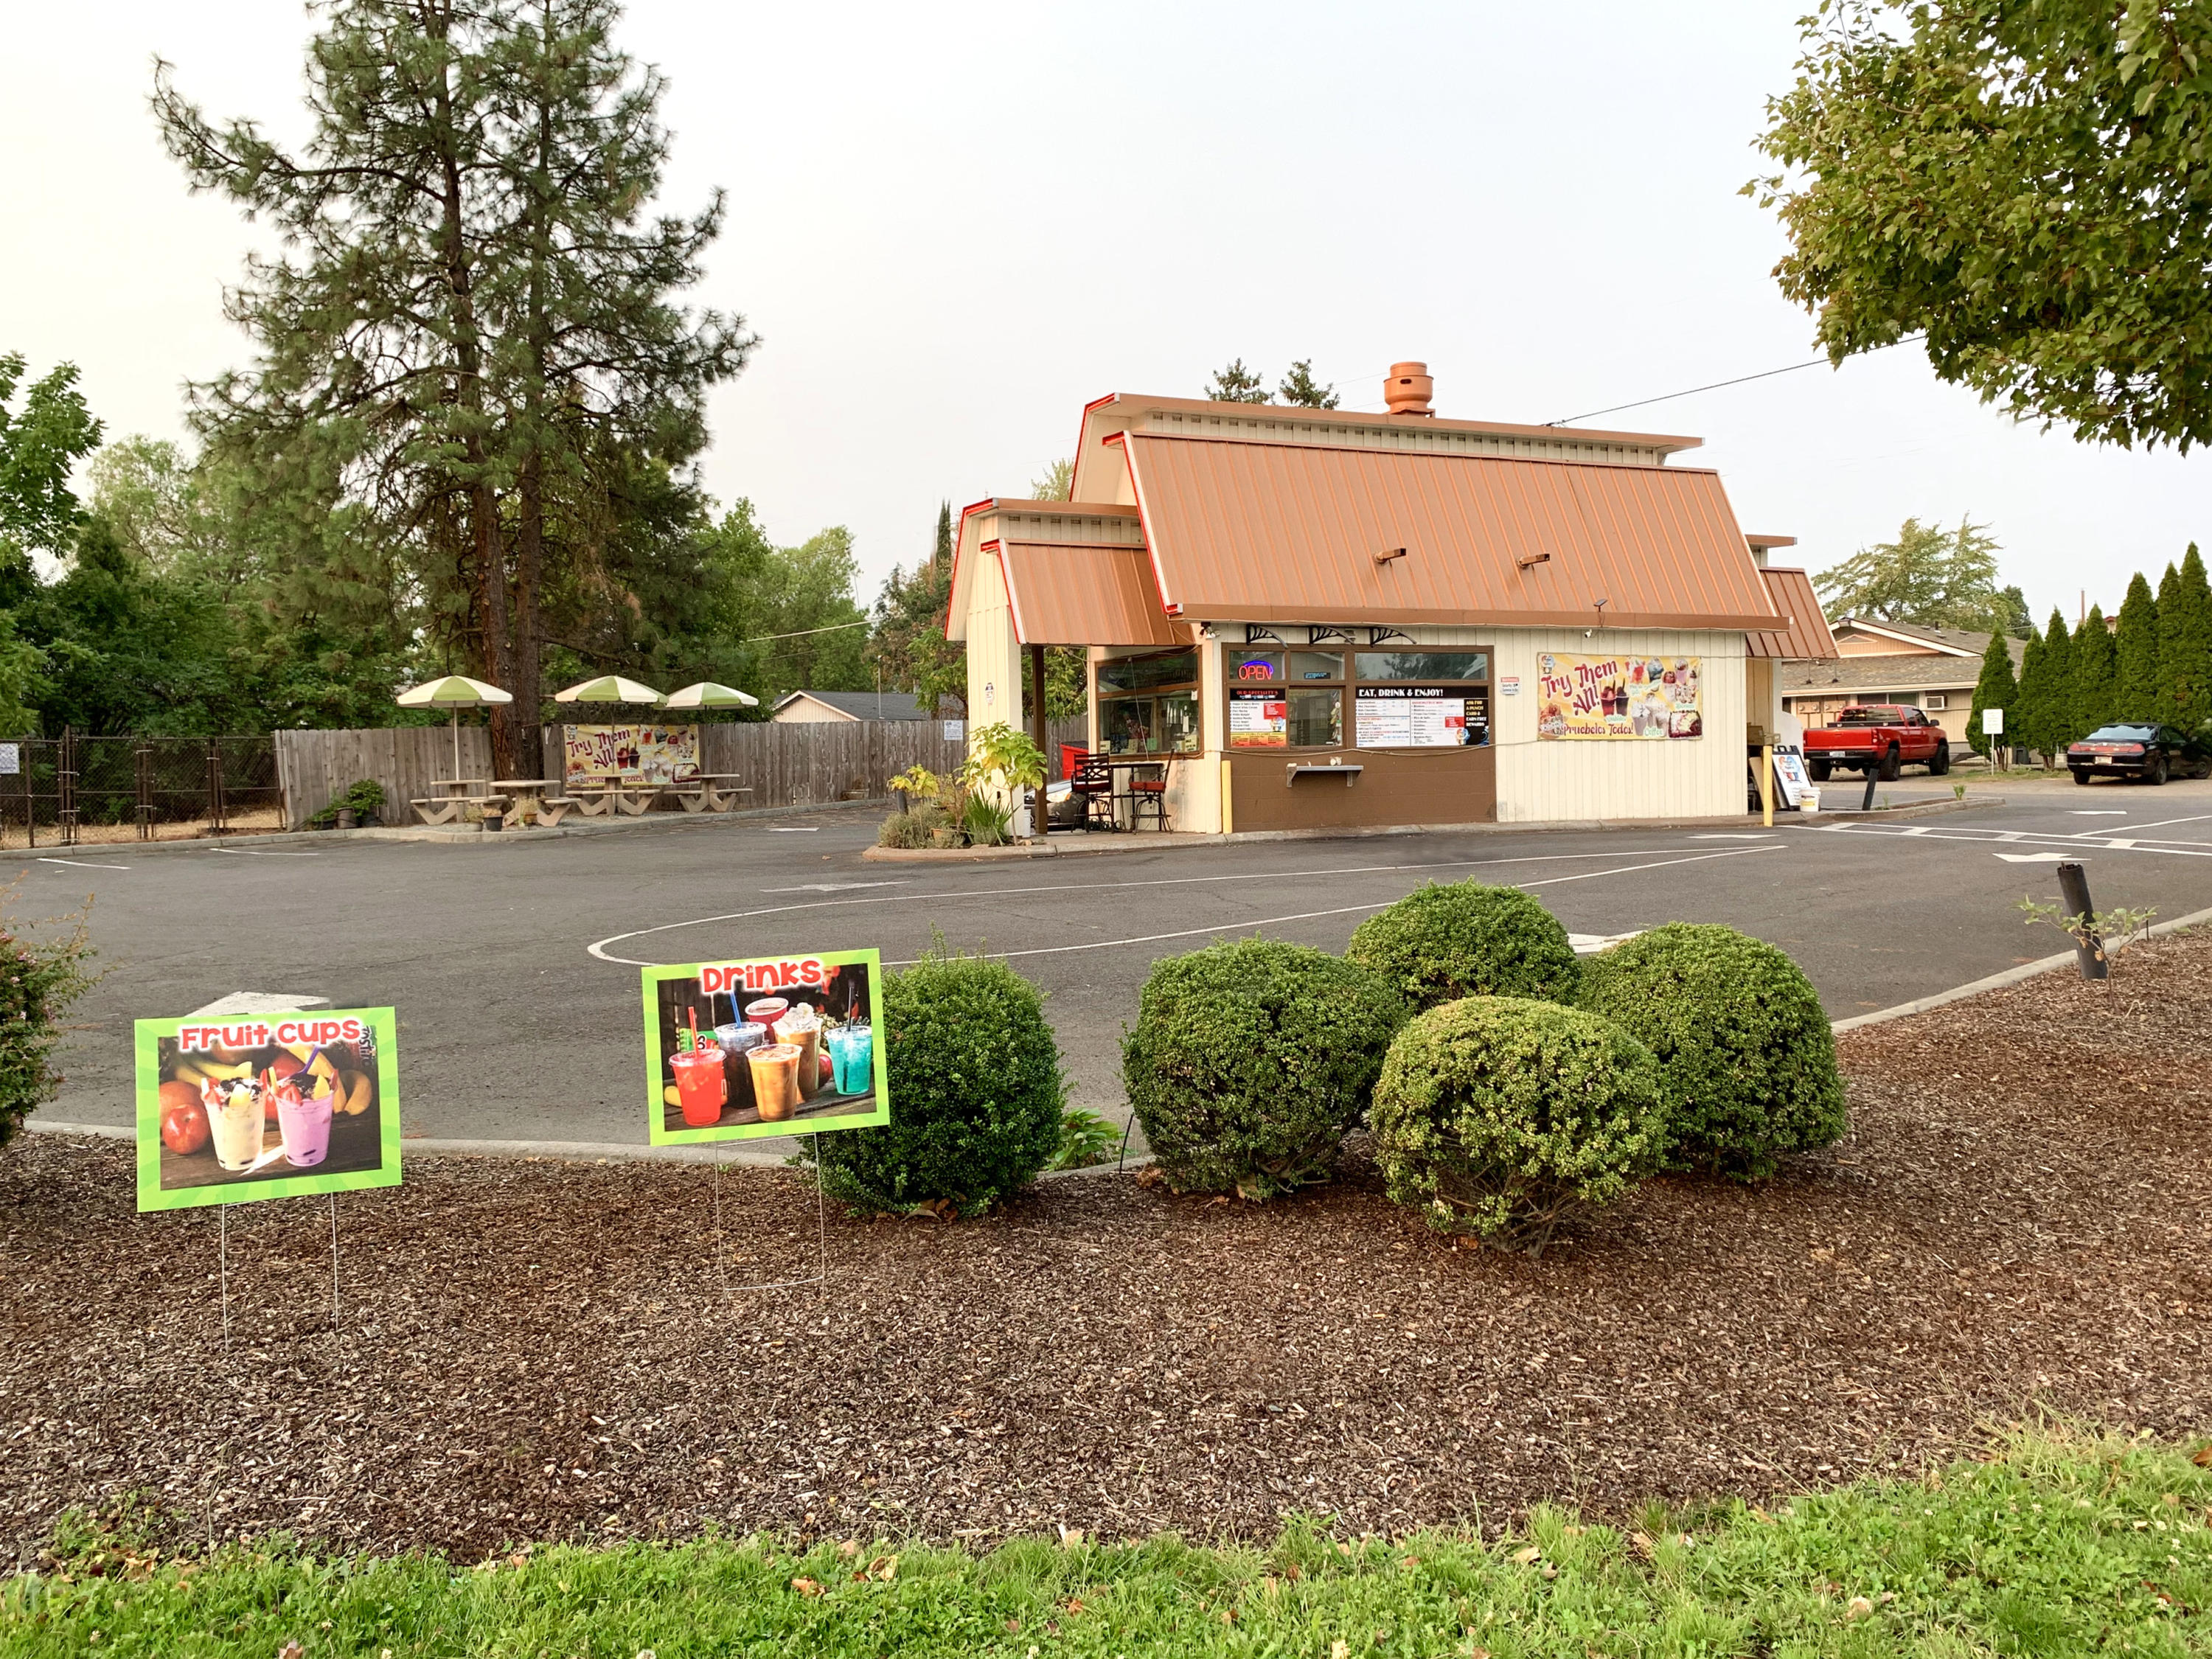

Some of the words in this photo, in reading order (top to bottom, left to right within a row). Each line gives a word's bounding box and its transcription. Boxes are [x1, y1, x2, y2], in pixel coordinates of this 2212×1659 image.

[1239, 665, 1272, 681] OPEN
[1541, 675, 1572, 698] Try
[1574, 661, 1618, 688] Them
[1359, 689, 1377, 698] EAT,
[1378, 689, 1405, 697] DRINK
[1414, 689, 1443, 697] ENJOY!
[1573, 685, 1599, 715] All!
[566, 740, 593, 757] Try
[594, 729, 630, 749] Them
[702, 959, 821, 993] Drinks
[181, 1024, 268, 1050] Fruit
